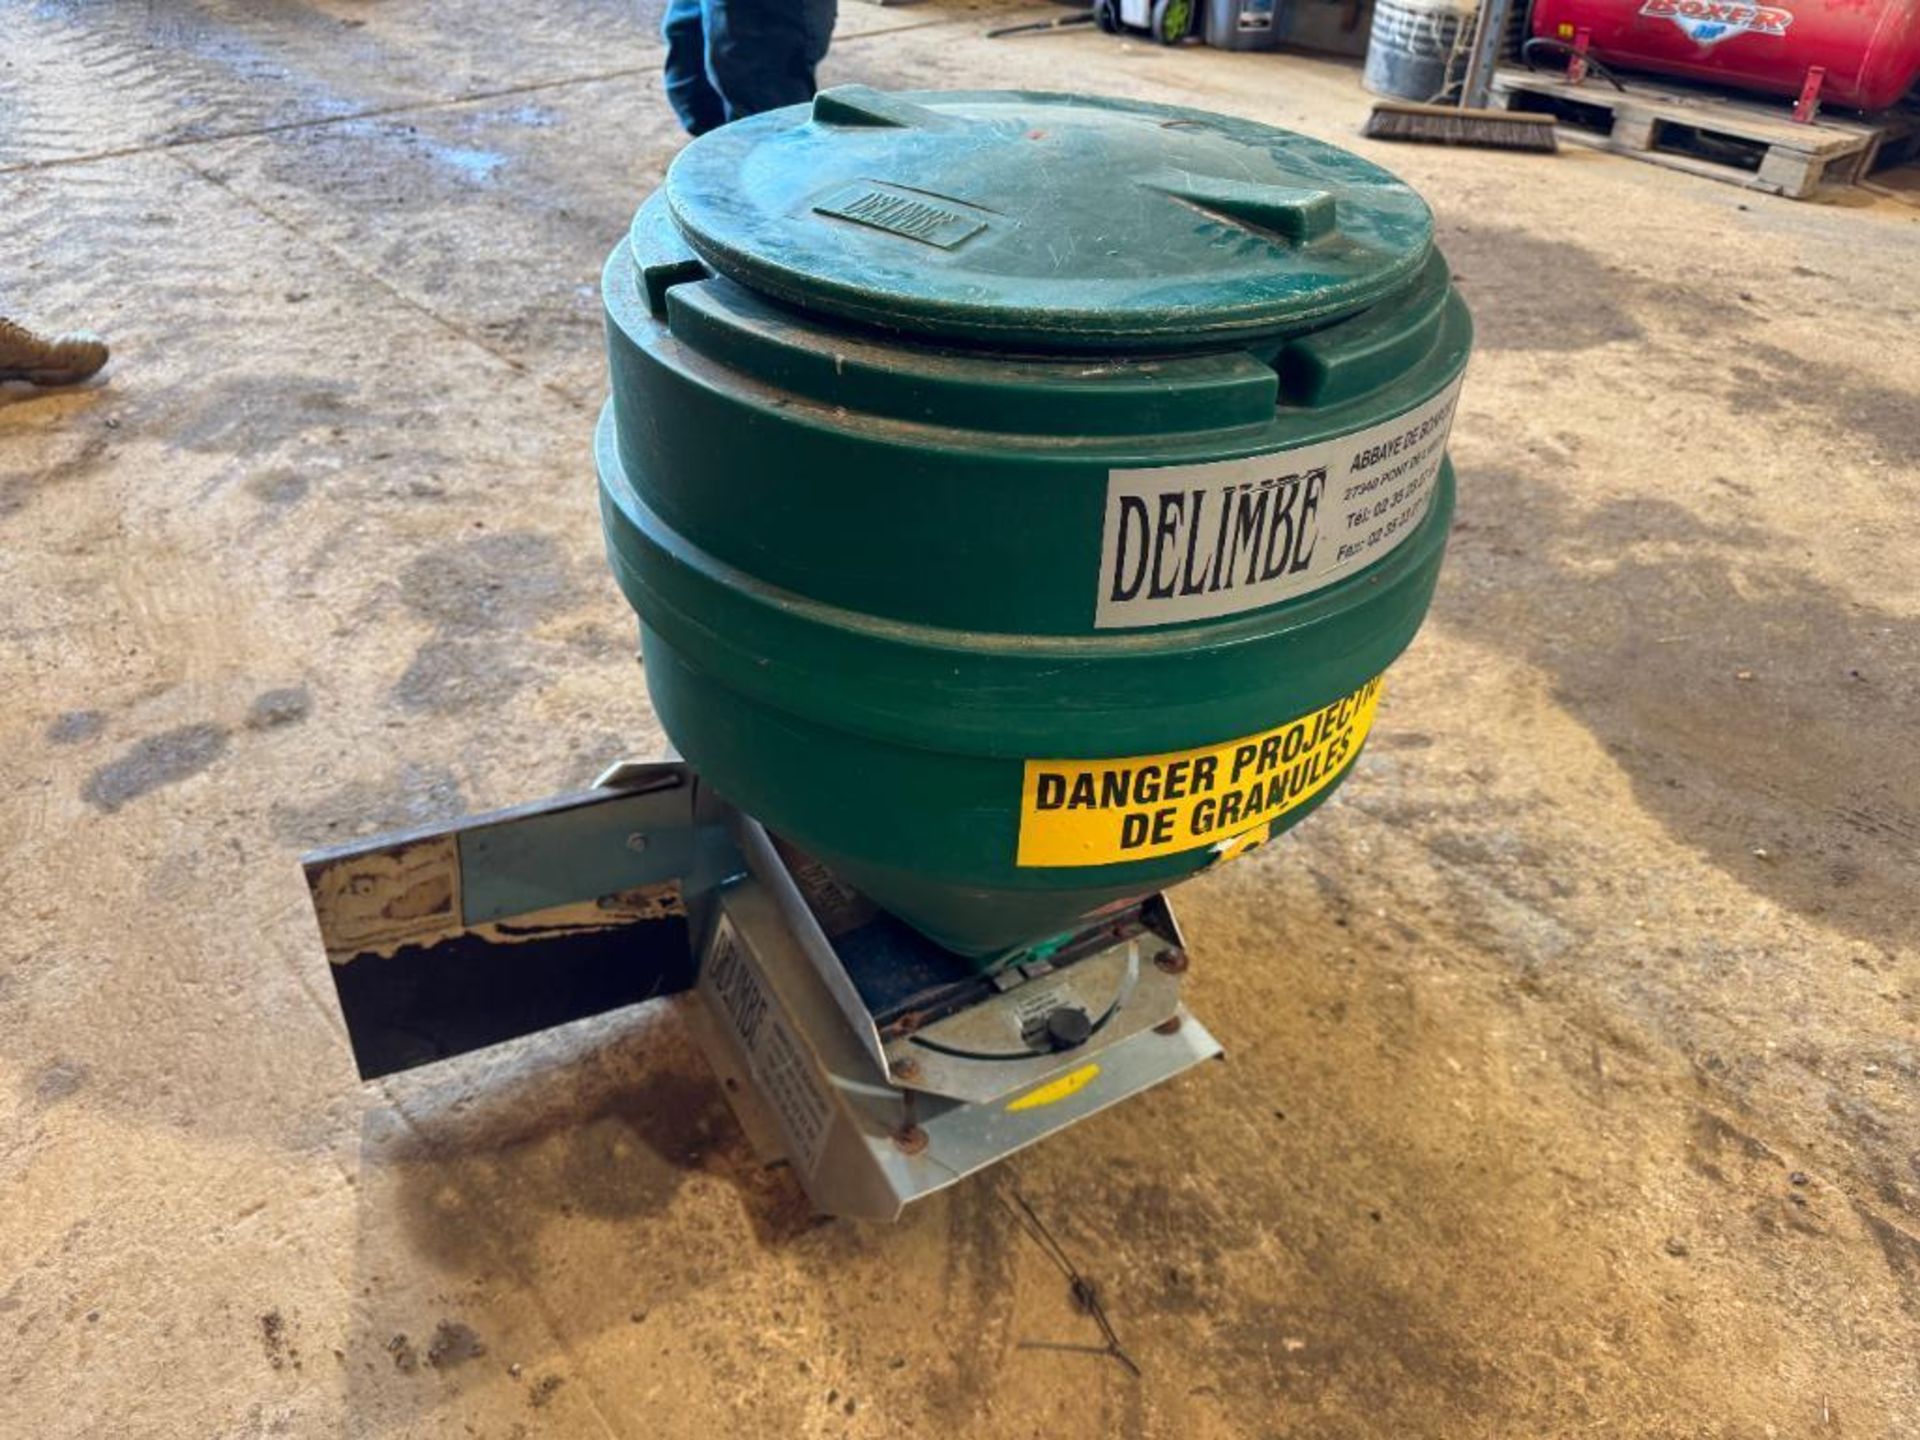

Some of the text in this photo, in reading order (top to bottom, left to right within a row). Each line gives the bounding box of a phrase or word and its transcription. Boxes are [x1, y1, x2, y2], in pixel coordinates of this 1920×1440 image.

[842, 192, 962, 240] DELIMBE
[1350, 435, 1402, 474] ABBAYE
[1402, 426, 1420, 450] DE
[1380, 460, 1409, 486] PONT
[1110, 466, 1330, 602] DELIMBE
[1346, 507, 1371, 529] Tél:
[1373, 497, 1390, 517] 02
[1367, 527, 1384, 547] 02
[1036, 755, 1218, 811] DANGER
[1120, 727, 1353, 850] DE GRANULES
